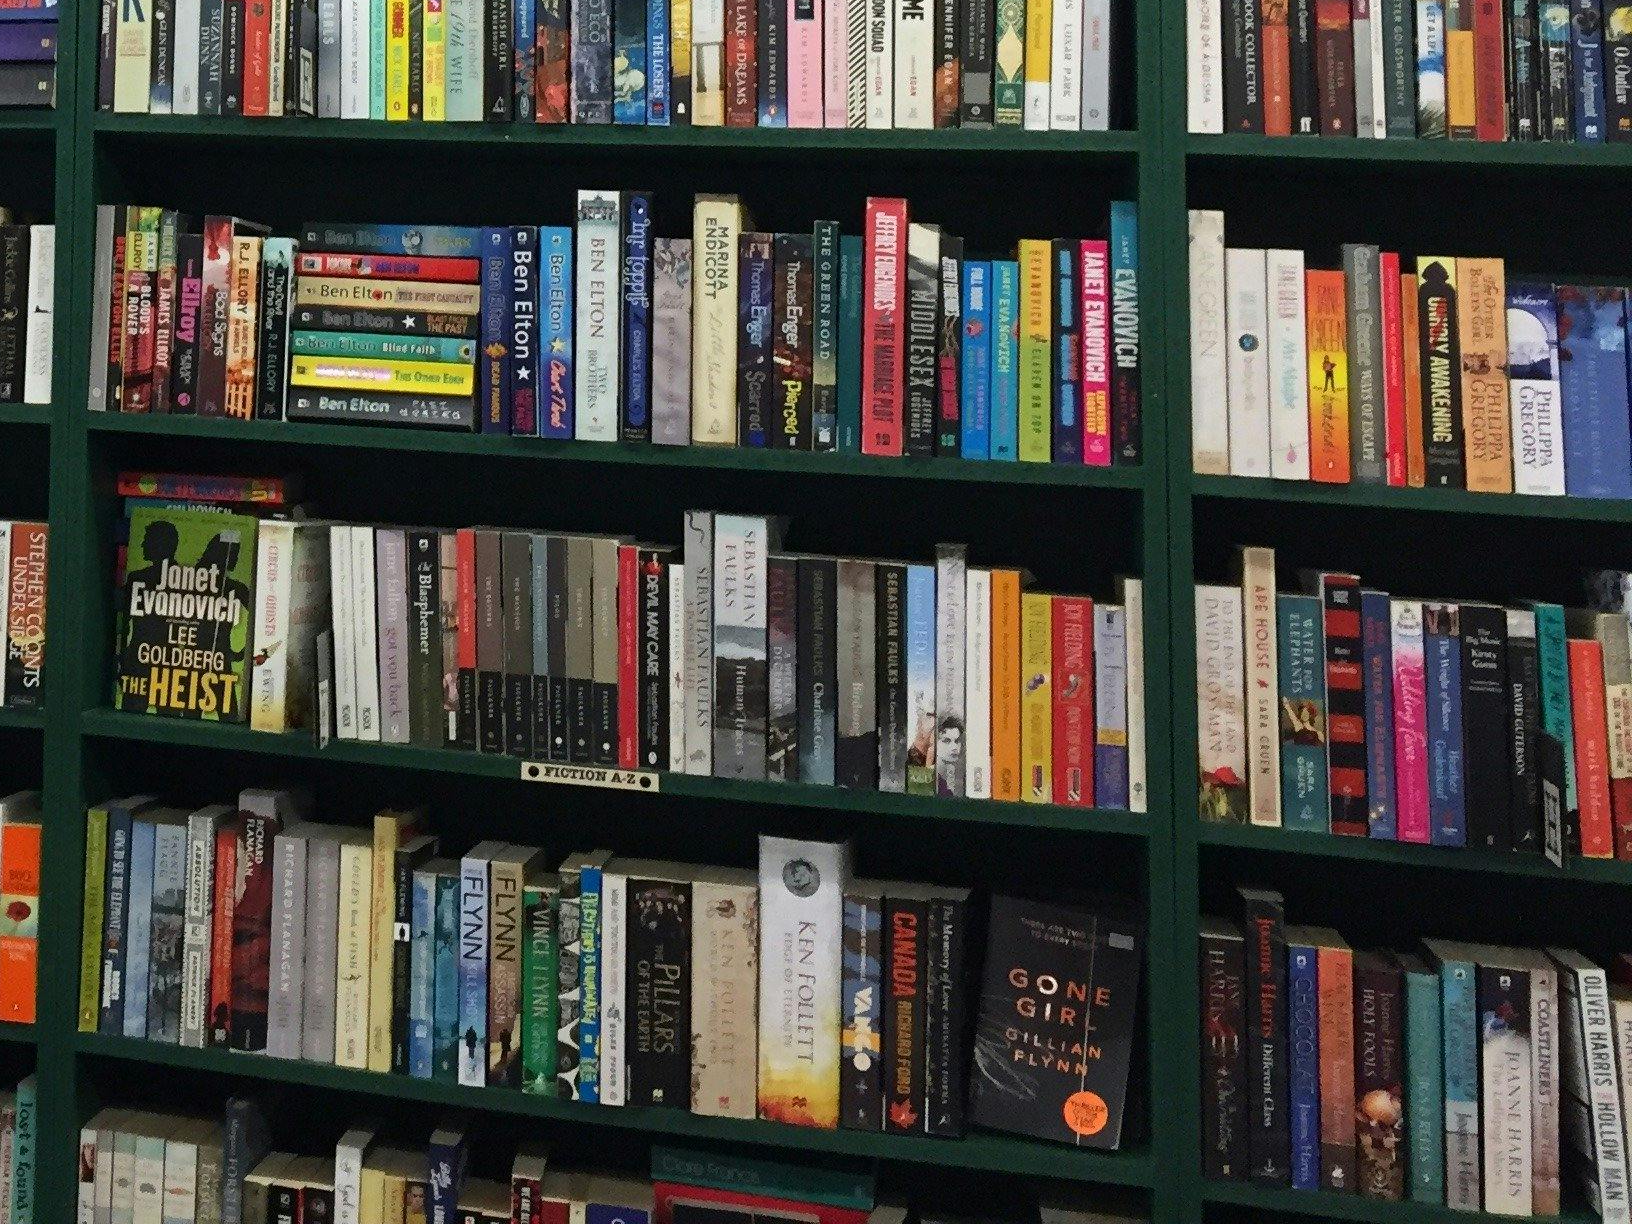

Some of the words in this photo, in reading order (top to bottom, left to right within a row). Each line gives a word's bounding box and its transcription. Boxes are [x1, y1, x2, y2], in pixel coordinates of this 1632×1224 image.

[514, 249, 532, 283] Ben
[705, 217, 718, 300] ENDICOTT
[717, 226, 730, 291] MARINA
[1085, 250, 1106, 295] JANET
[321, 283, 349, 301] Ben
[352, 285, 393, 302] Elton
[512, 288, 532, 359] Elton
[1084, 299, 1106, 384] EVANOVICH
[1519, 386, 1537, 470] GREGORY
[1537, 389, 1553, 470] PHILIPPA
[28, 532, 46, 608] STEPHEN
[158, 560, 220, 594] Janet
[130, 583, 241, 624] Evanovich
[24, 613, 44, 688] COONTS
[137, 643, 224, 671] GOLDBERG
[167, 622, 198, 646] LEE
[122, 678, 147, 696] THE
[149, 670, 239, 714] HEIST
[546, 765, 605, 783] FICTION
[610, 771, 636, 784] A-Z
[462, 876, 484, 962] FLYNN
[493, 876, 516, 965] FLYNN
[797, 921, 816, 966] KEN
[893, 911, 917, 997] CANADA
[653, 962, 681, 1053] PILLARS
[1008, 967, 1111, 1007] GONE
[795, 972, 817, 1065] FOLLETT
[1005, 1028, 1102, 1059] GILLIAN
[1014, 1050, 1088, 1076] FLYNN
